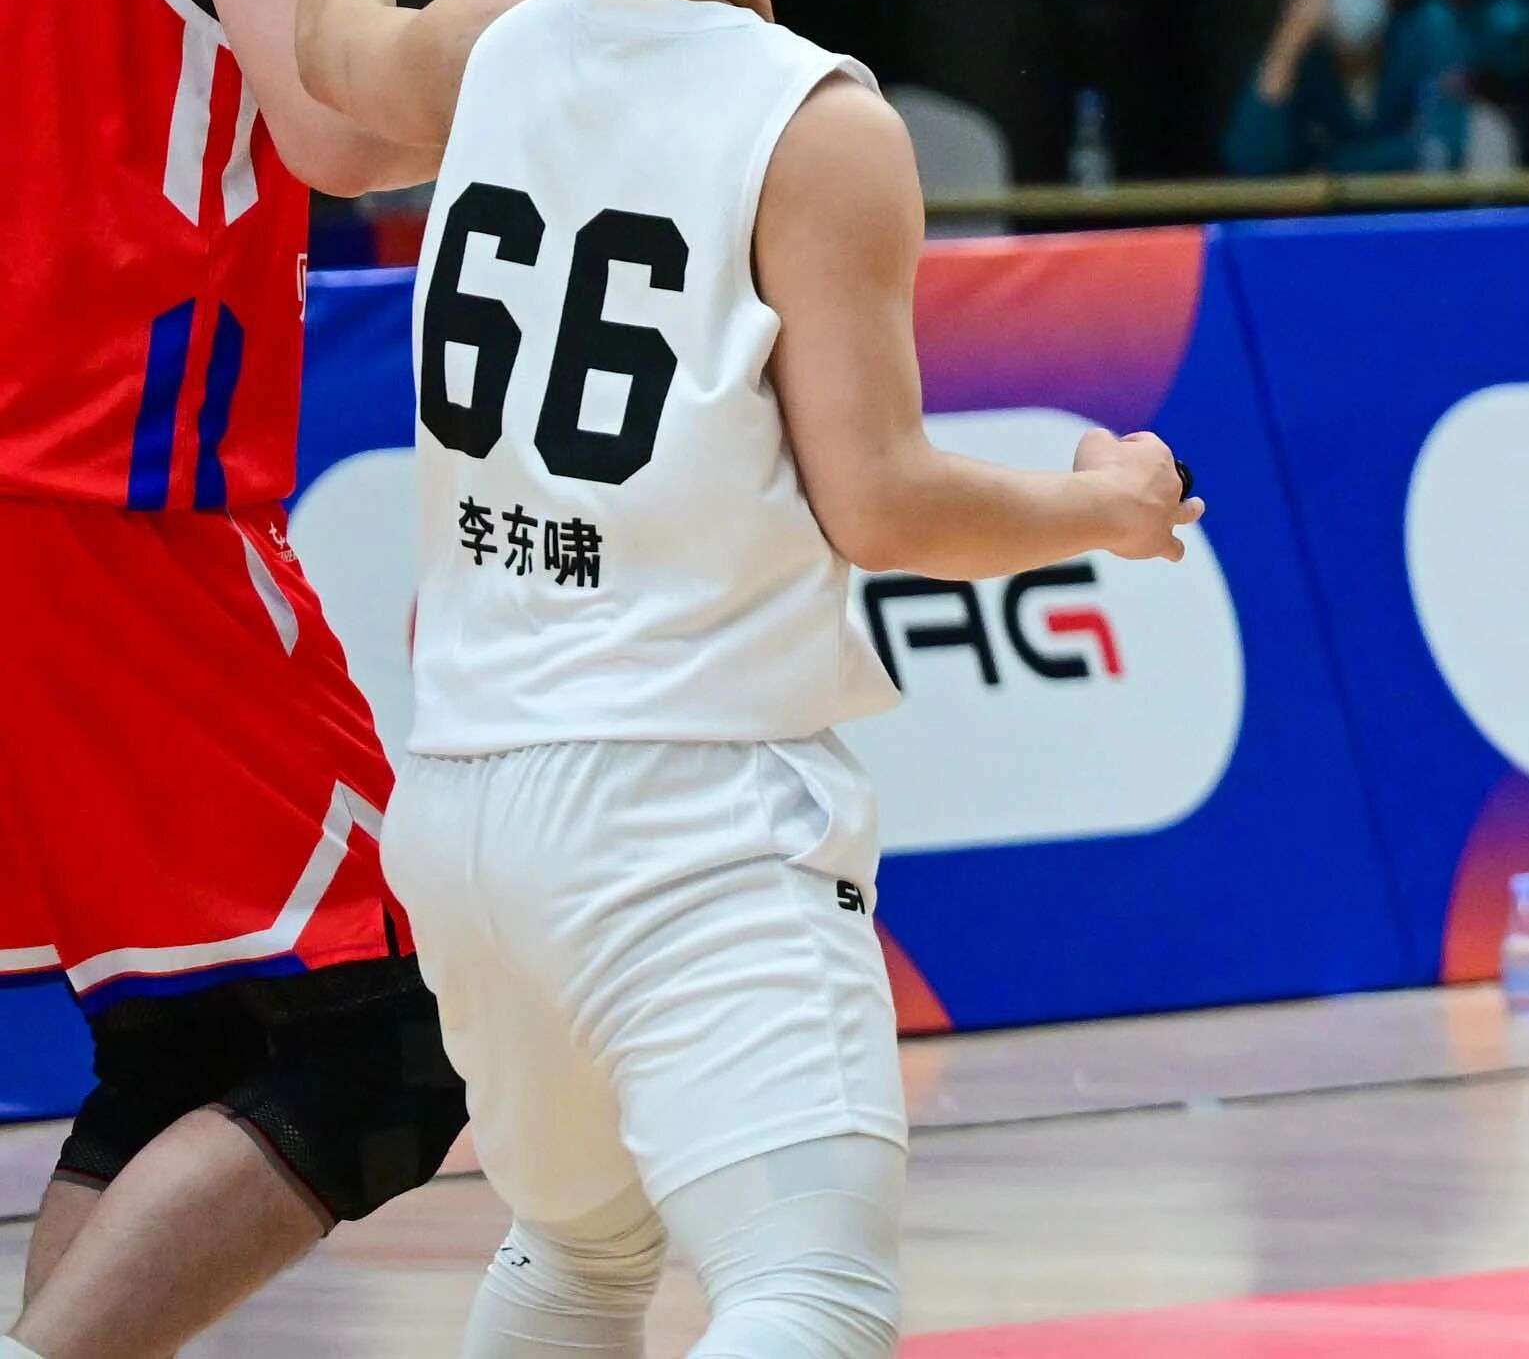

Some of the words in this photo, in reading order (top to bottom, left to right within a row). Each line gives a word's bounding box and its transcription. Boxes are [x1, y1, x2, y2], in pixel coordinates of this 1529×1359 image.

[420, 182, 690, 486] 66
[459, 495, 602, 589] 李东啸
